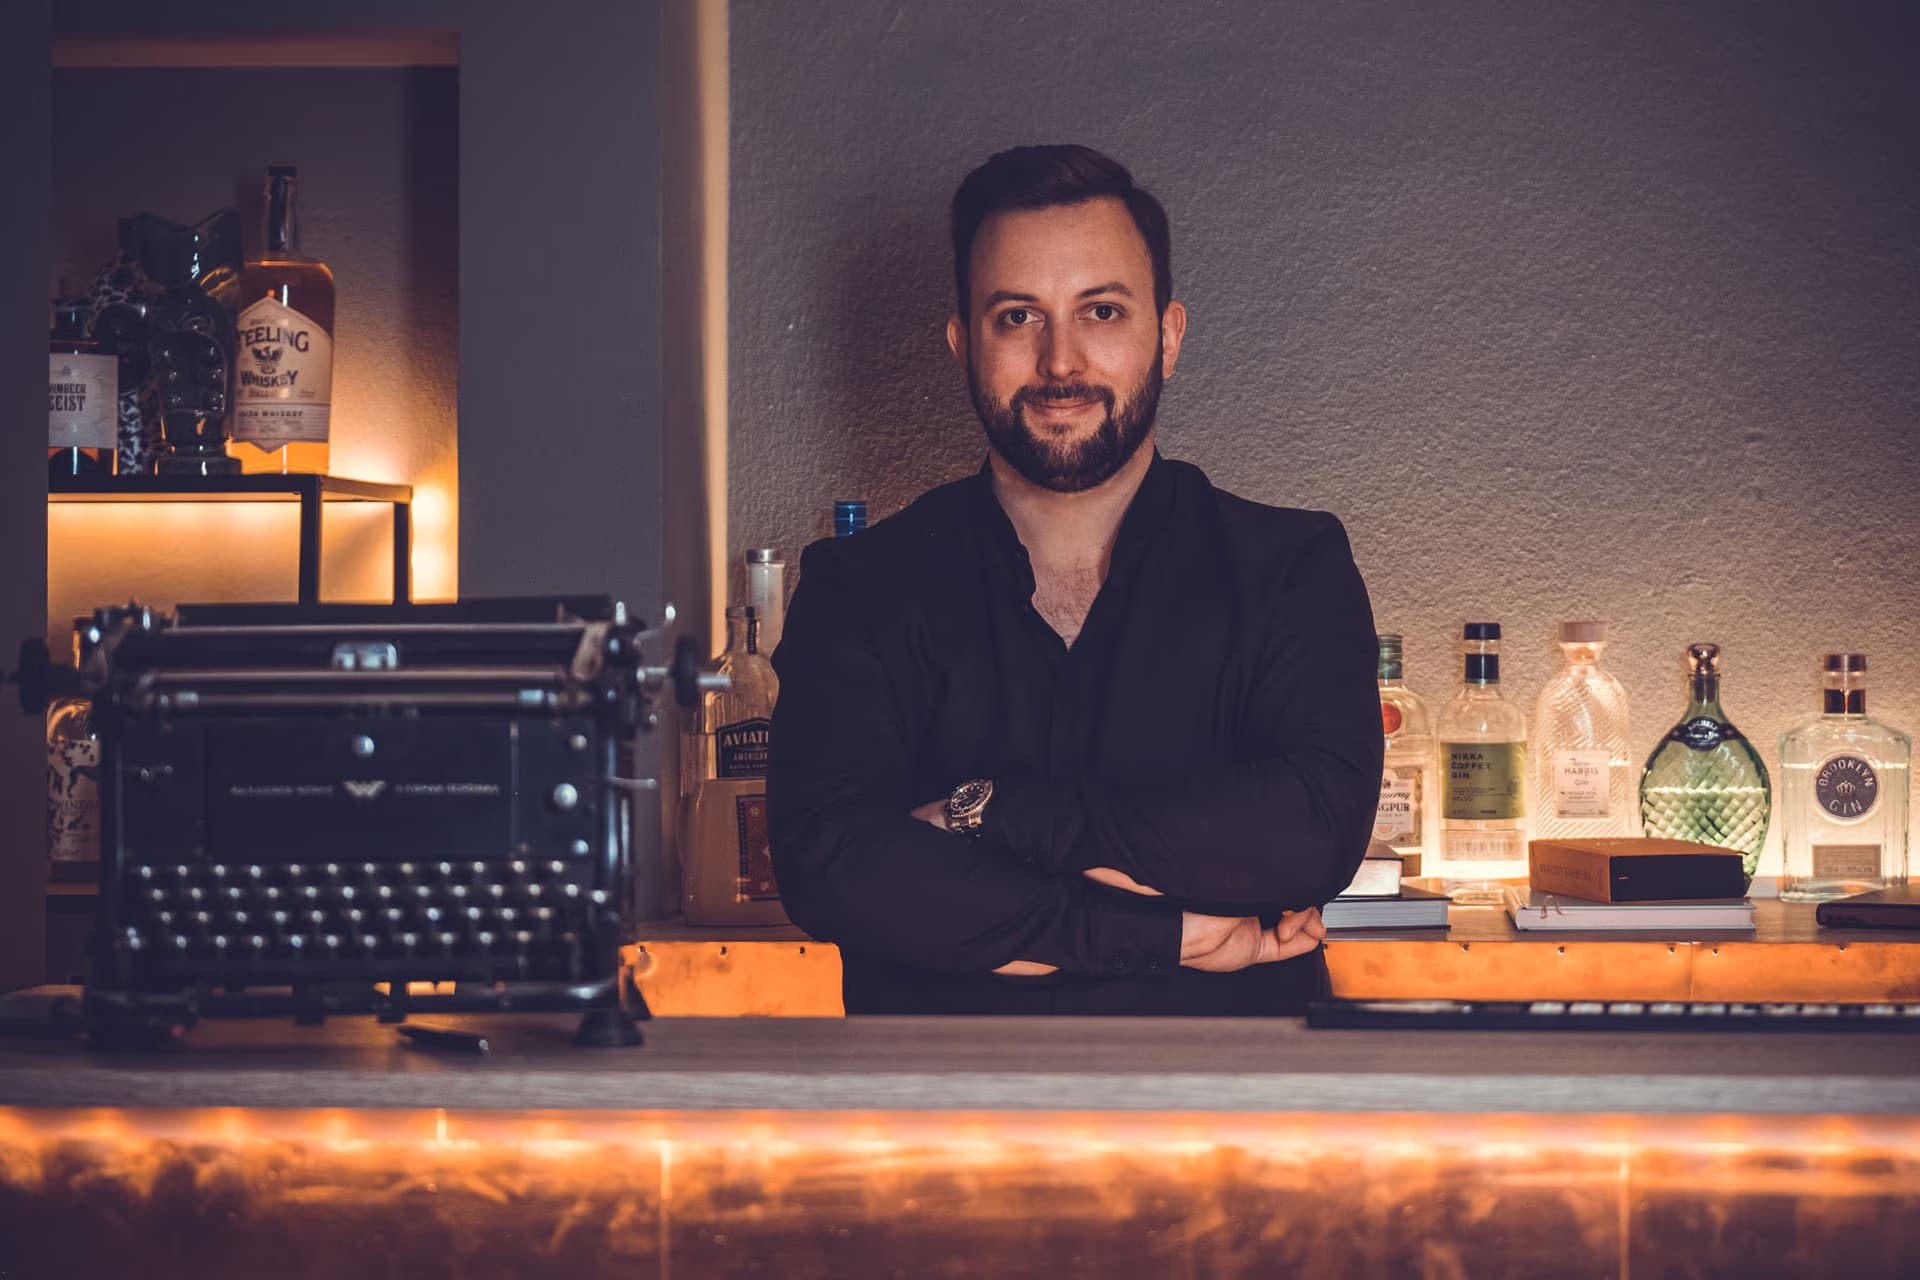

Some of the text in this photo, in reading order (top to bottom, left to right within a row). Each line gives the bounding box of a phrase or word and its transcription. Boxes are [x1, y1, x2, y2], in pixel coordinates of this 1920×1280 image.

[240, 370, 298, 387] WHISKEY
[723, 730, 769, 747] AVIATI
[1451, 752, 1484, 760] NIKKA
[1451, 762, 1492, 770] COFFEY
[1818, 759, 1874, 787] BROOKLYN
[1829, 799, 1862, 814] GIN
